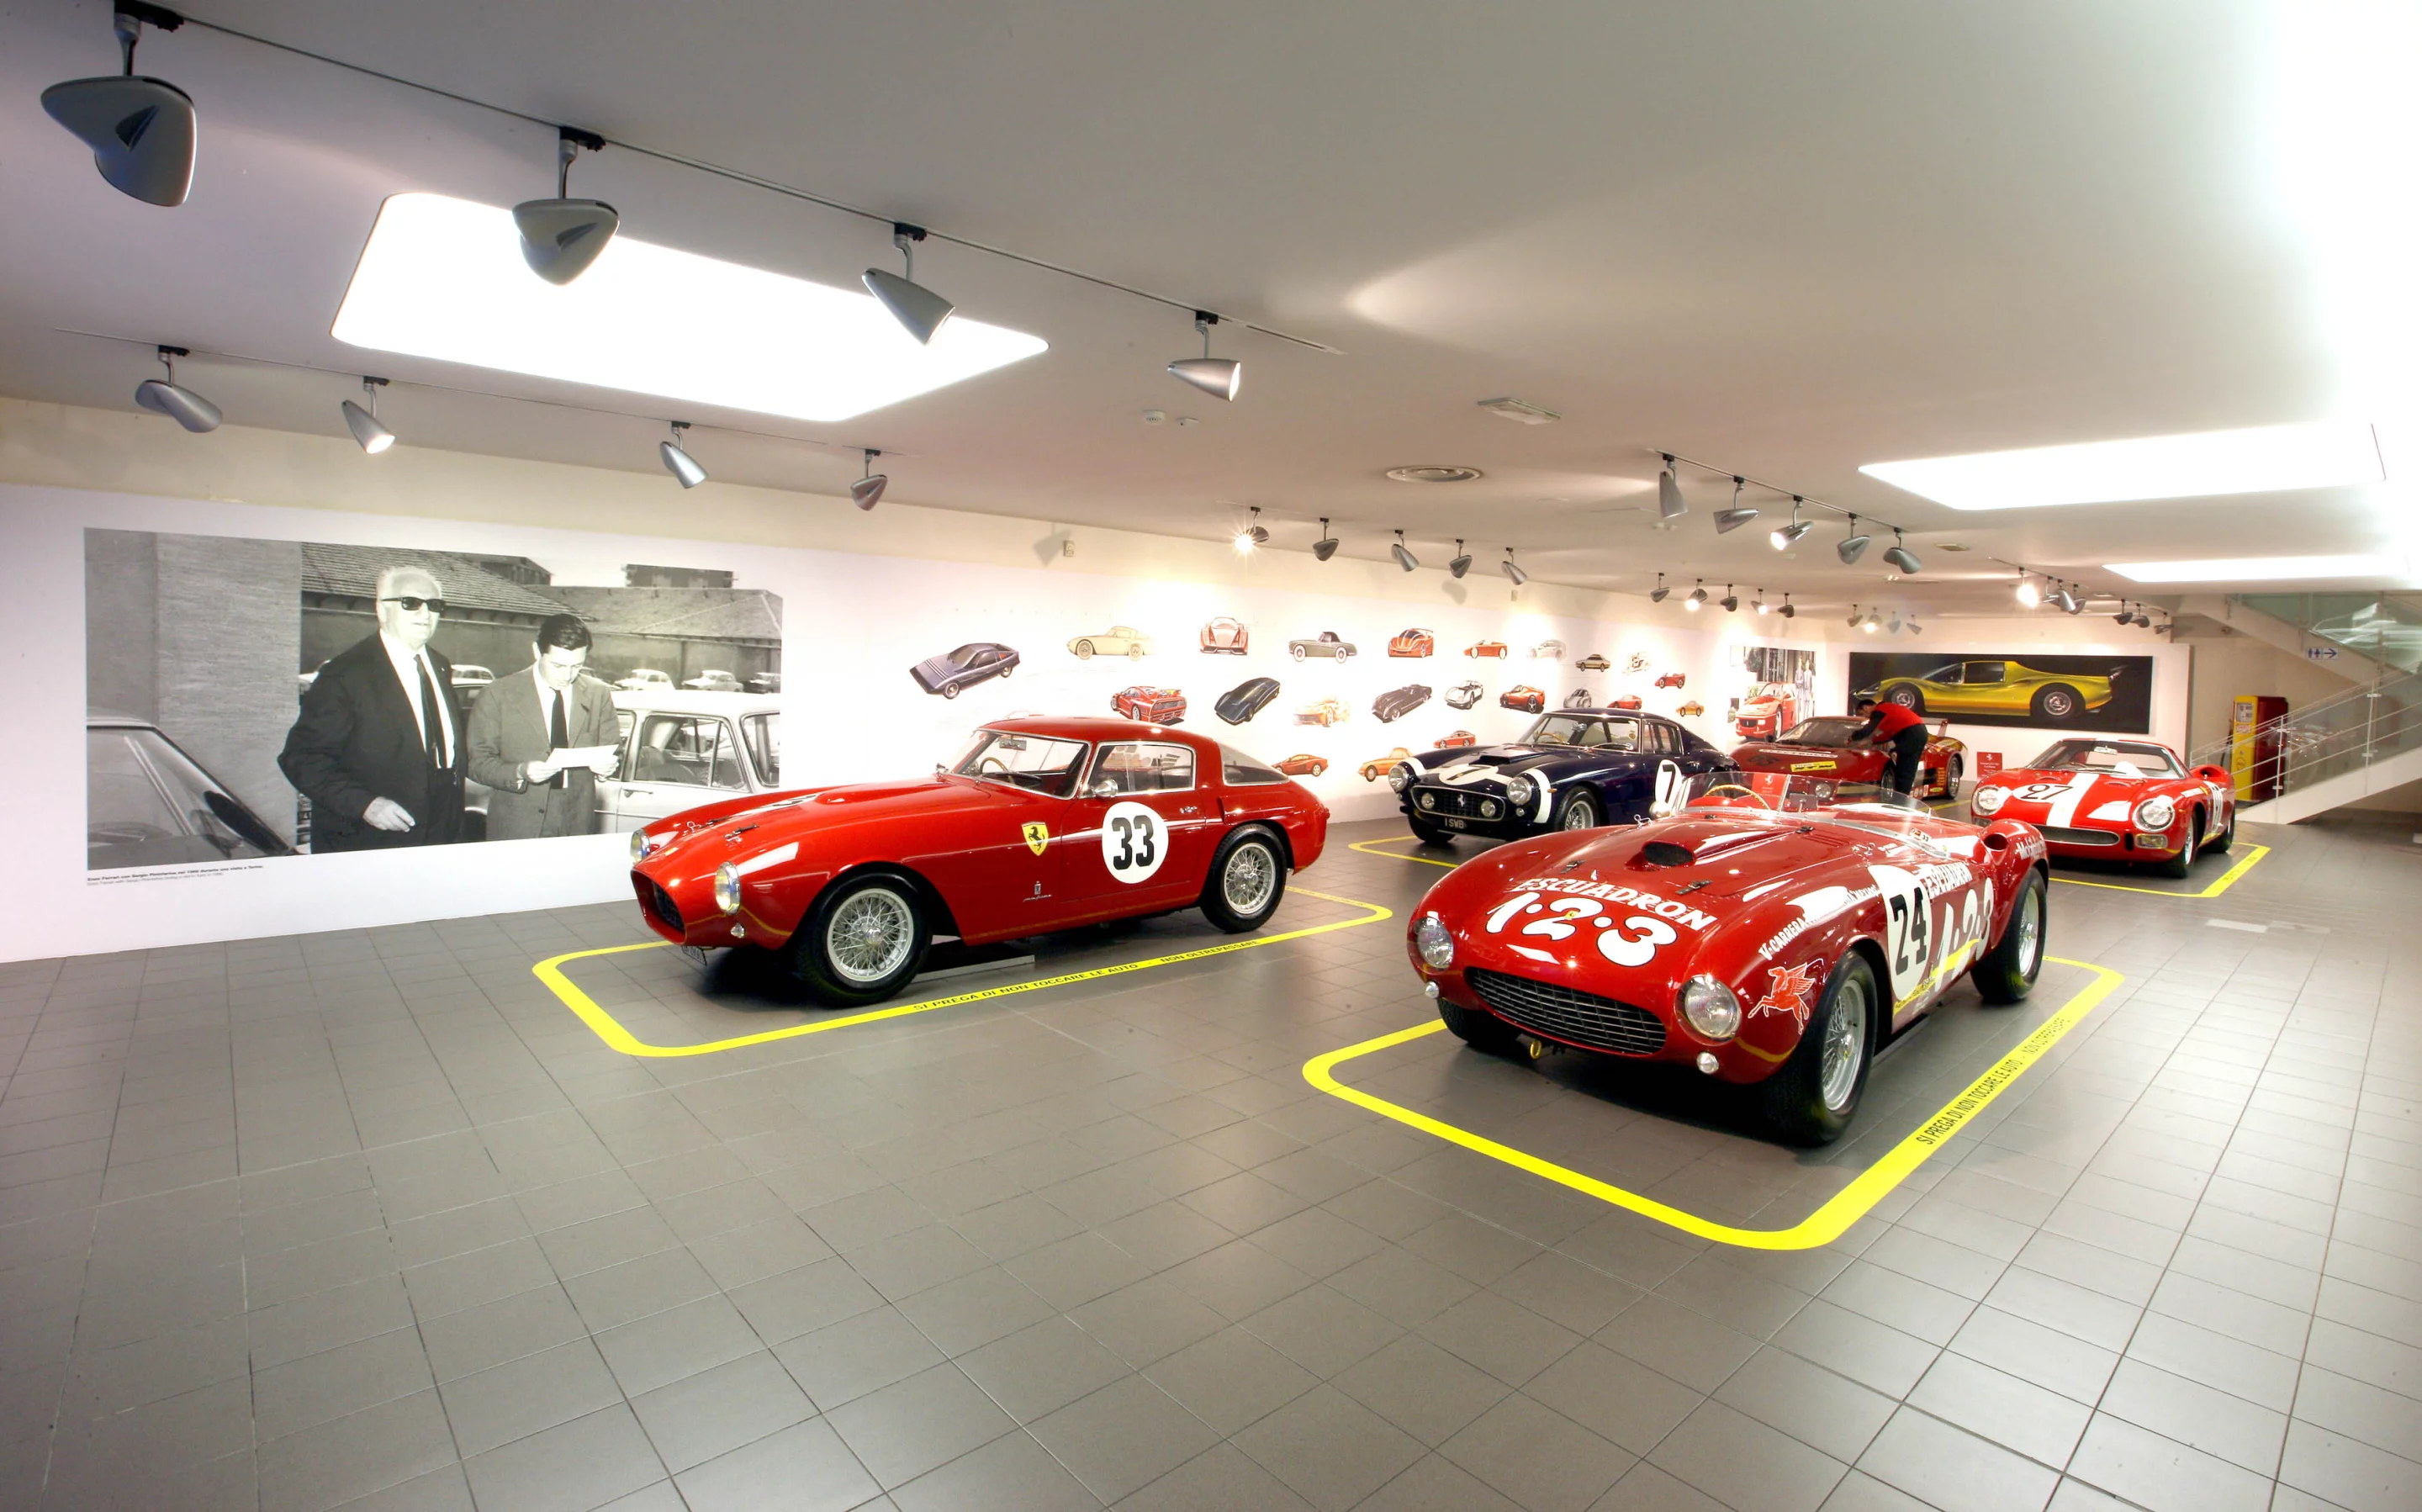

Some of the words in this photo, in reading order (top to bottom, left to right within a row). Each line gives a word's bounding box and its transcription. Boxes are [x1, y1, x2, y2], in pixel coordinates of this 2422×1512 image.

[1446, 765, 1490, 781] 7
[1663, 764, 1676, 803] 7
[2020, 784, 2074, 800] 27
[1111, 815, 1155, 870] 33
[1510, 877, 1718, 931] ESCUADRON
[1889, 886, 1928, 975] 24
[933, 994, 979, 1007] PREGA
[982, 990, 996, 998] DI
[1000, 984, 1029, 994] NON
[1034, 973, 1088, 987] TOCCARE
[1108, 964, 1139, 973] AUTO
[1160, 954, 1185, 964] NON
[2000, 1059, 2023, 1074] AUTO
[1967, 1076, 2003, 1101] TOCCARE
[1946, 1109, 1965, 1119] DI
[1954, 1097, 1980, 1113] NON
[1924, 1116, 1958, 1139] PREGA
[1916, 1134, 1936, 1145] SI
